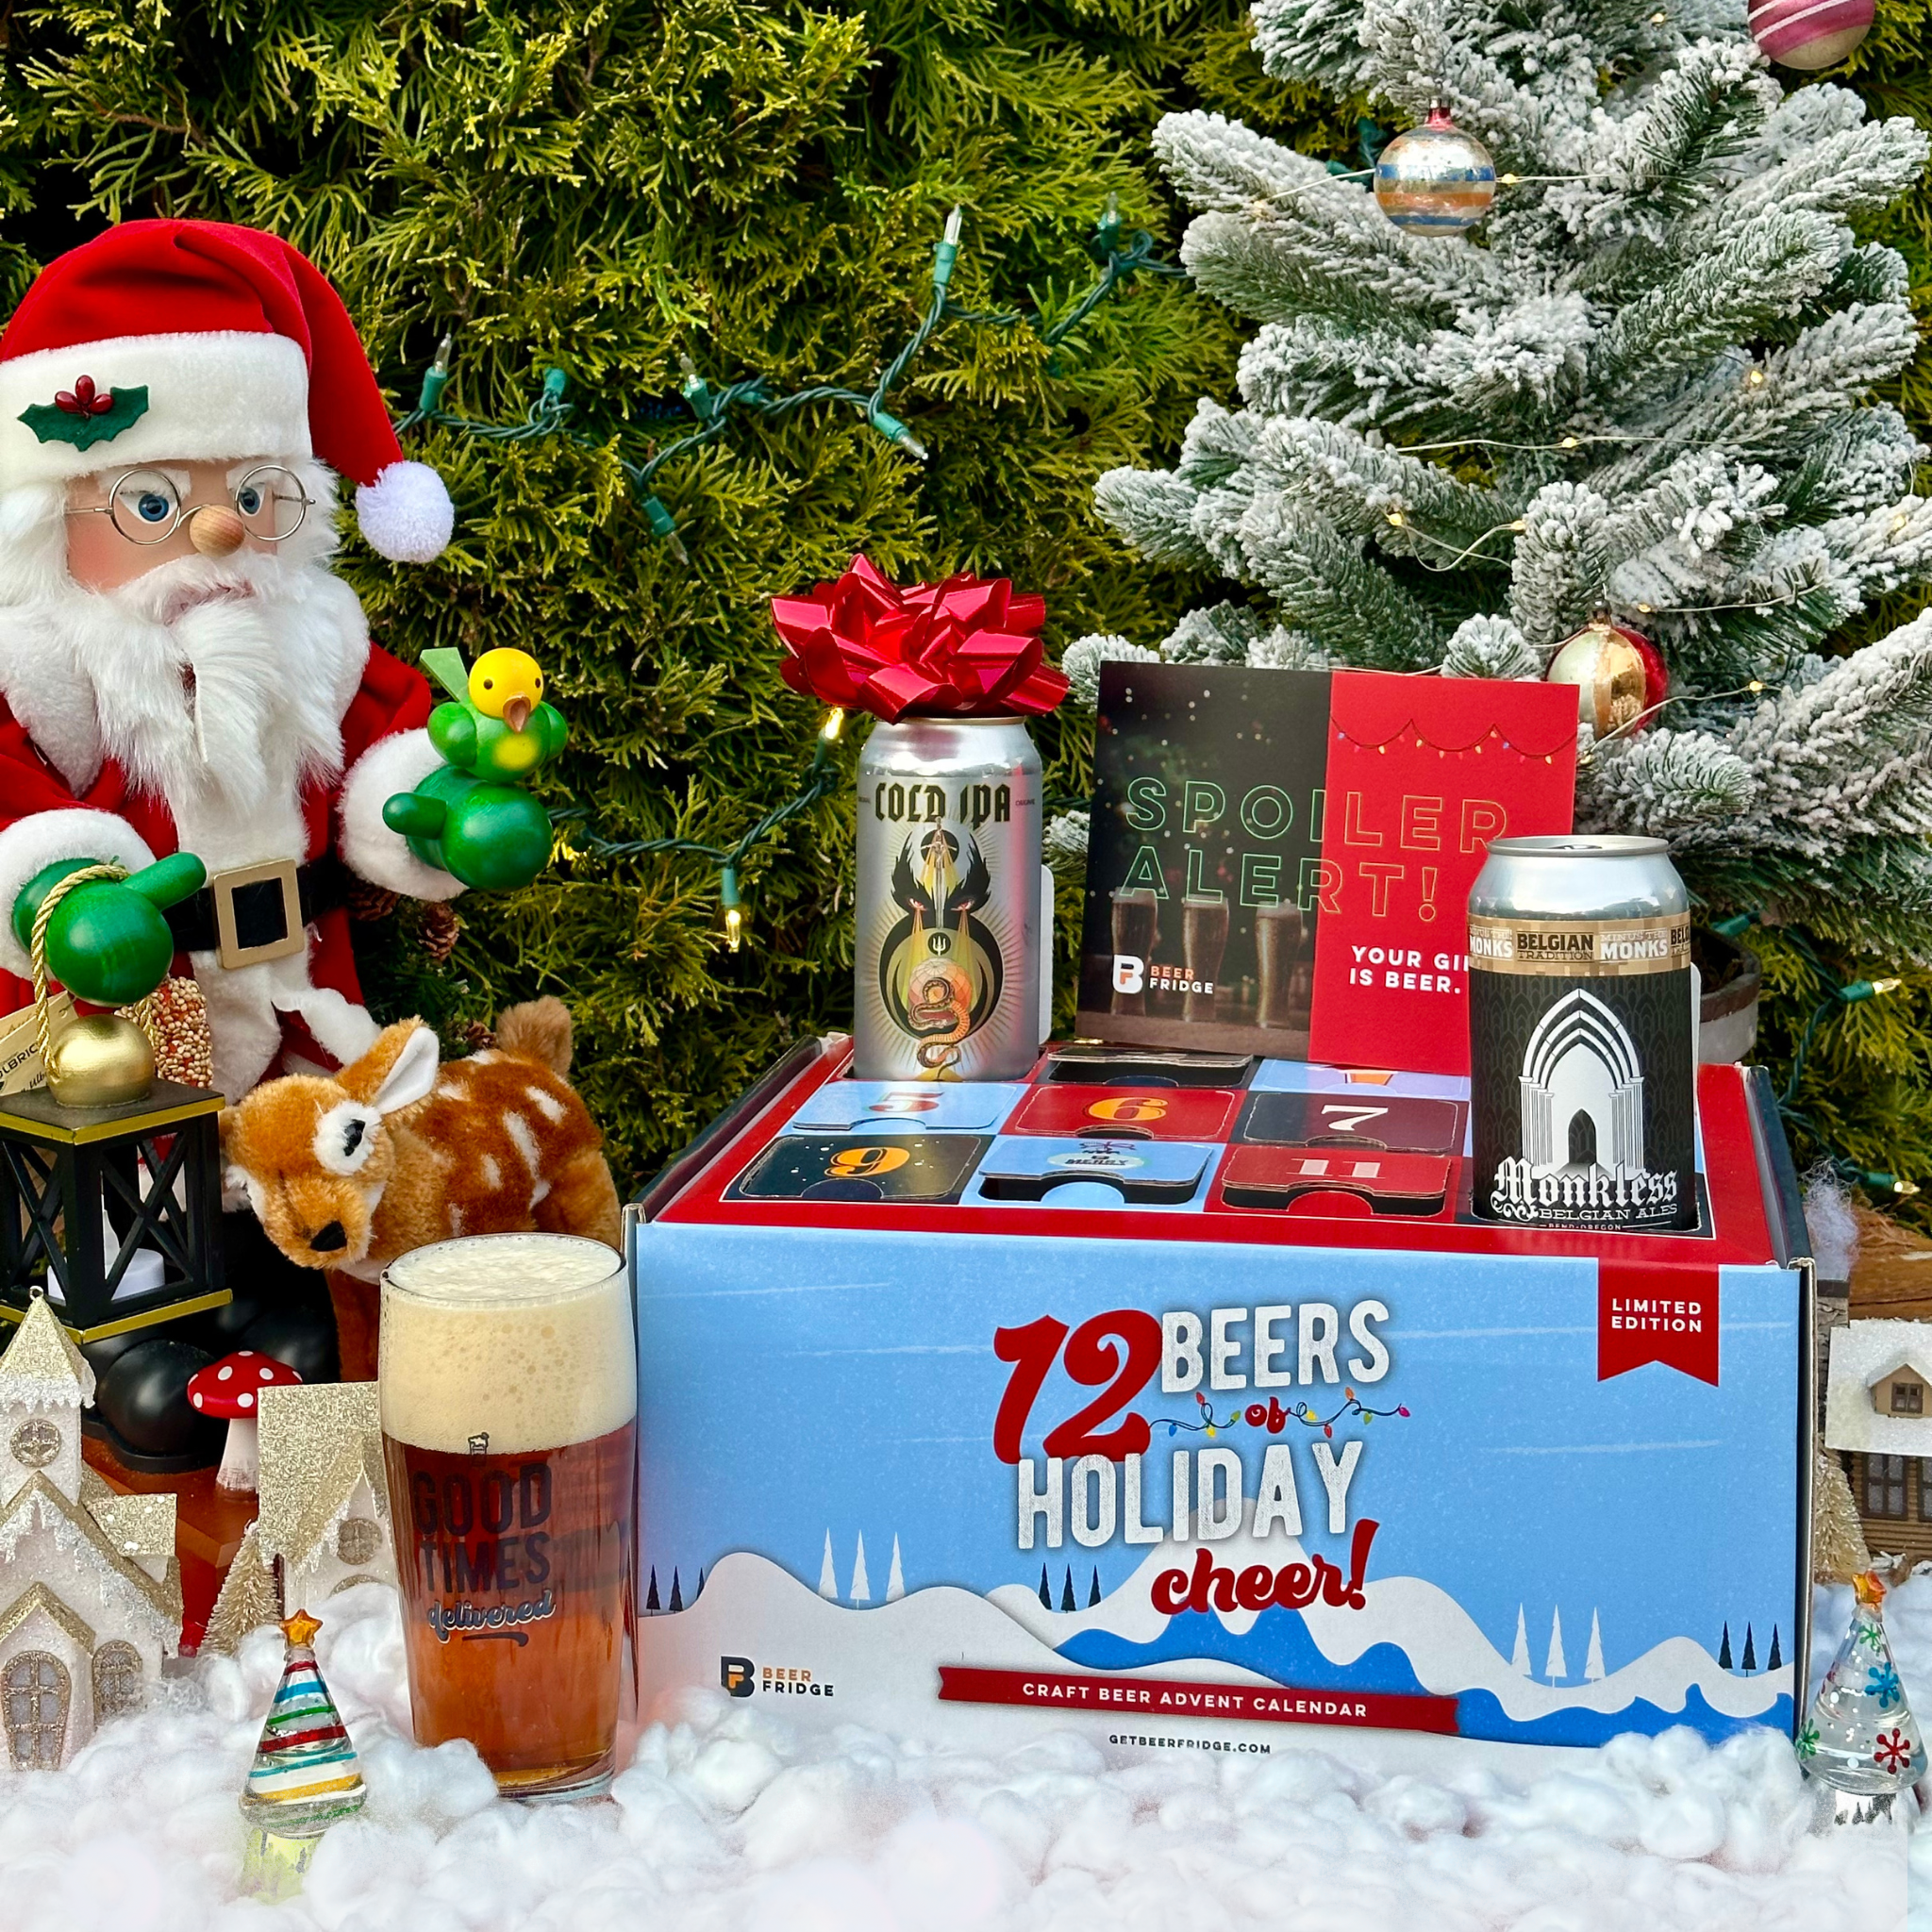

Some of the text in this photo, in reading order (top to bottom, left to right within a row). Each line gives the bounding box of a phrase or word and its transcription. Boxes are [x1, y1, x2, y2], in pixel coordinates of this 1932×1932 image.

[874, 782, 1010, 830] COLD IPA
[1125, 776, 1507, 853] SPOILER
[1119, 845, 1439, 923] ALERT!
[1469, 934, 1513, 958] MONKS
[1517, 933, 1594, 951] BELGIAN
[1600, 932, 1644, 942] MINUS
[1351, 945, 1422, 968] YOUR
[1518, 950, 1594, 960] TRADITION
[1600, 940, 1668, 960] MONKS
[1150, 965, 1195, 980] BEER
[1349, 967, 1461, 994] IS BEER.
[1149, 977, 1214, 994] FRIDGE
[863, 1091, 945, 1113] 5
[1087, 1096, 1169, 1122] 6
[1321, 1104, 1389, 1131] 7
[824, 1145, 911, 1178] 9
[1287, 1158, 1386, 1179] 11
[1491, 1156, 1678, 1216] Monkless
[1539, 1203, 1678, 1221] BELGIAN ALES
[1611, 1297, 1702, 1315] LIMITED
[1611, 1315, 1702, 1333] EDITION
[992, 1299, 1391, 1465] 12 BEERS
[412, 1462, 553, 1538] GOOD
[1017, 1441, 1364, 1550] HOLIDAY
[419, 1530, 552, 1594] TIMES
[1150, 1518, 1381, 1615] cheer!
[427, 1590, 557, 1644] delivered
[762, 1666, 812, 1682] BEER
[762, 1680, 834, 1697] FRIDGE
[1023, 1682, 1368, 1718] CRAFT BEER ADVENT CALENDAR
[1108, 1734, 1272, 1755] GETBEERFRIDGE.COM
